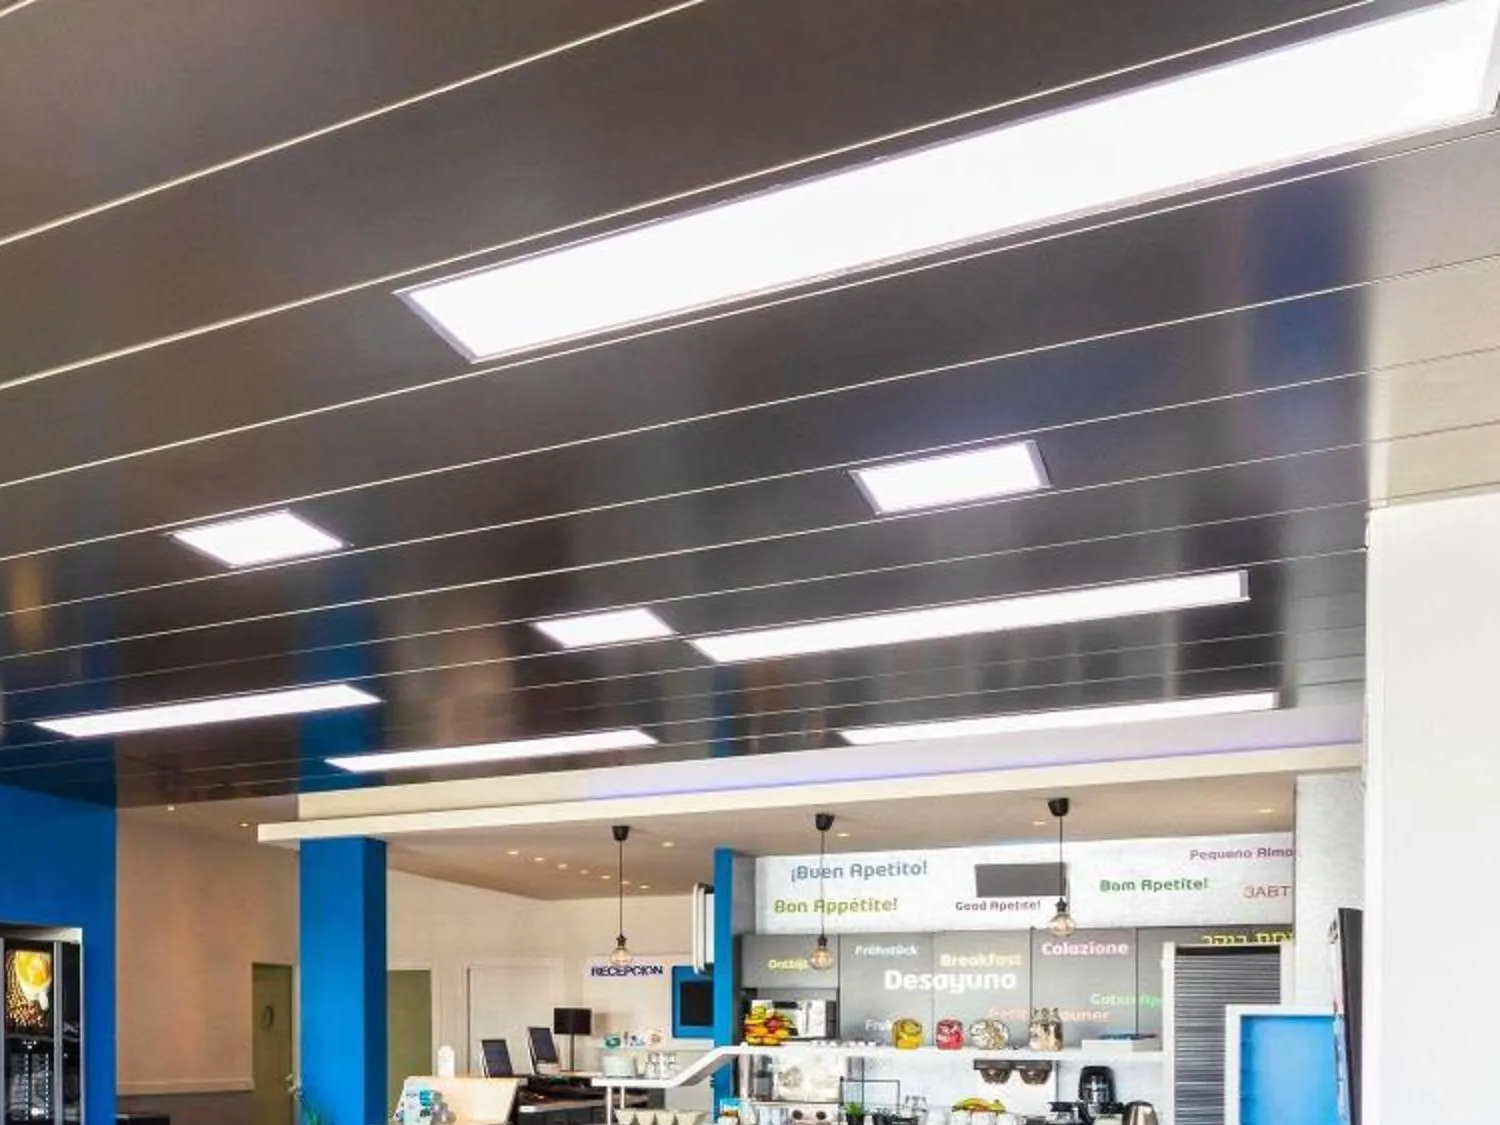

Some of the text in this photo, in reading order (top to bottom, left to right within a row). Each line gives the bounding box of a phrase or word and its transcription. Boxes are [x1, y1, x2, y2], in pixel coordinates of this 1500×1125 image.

[791, 861, 928, 882] ¡Buen Apetito!
[1100, 877, 1209, 893] Bom Apetite!
[774, 900, 808, 913] Bon
[955, 901, 987, 911] Good
[1041, 940, 1130, 956] Colazione
[939, 953, 1024, 968] Breakfast
[884, 969, 1017, 994] Desayuno
